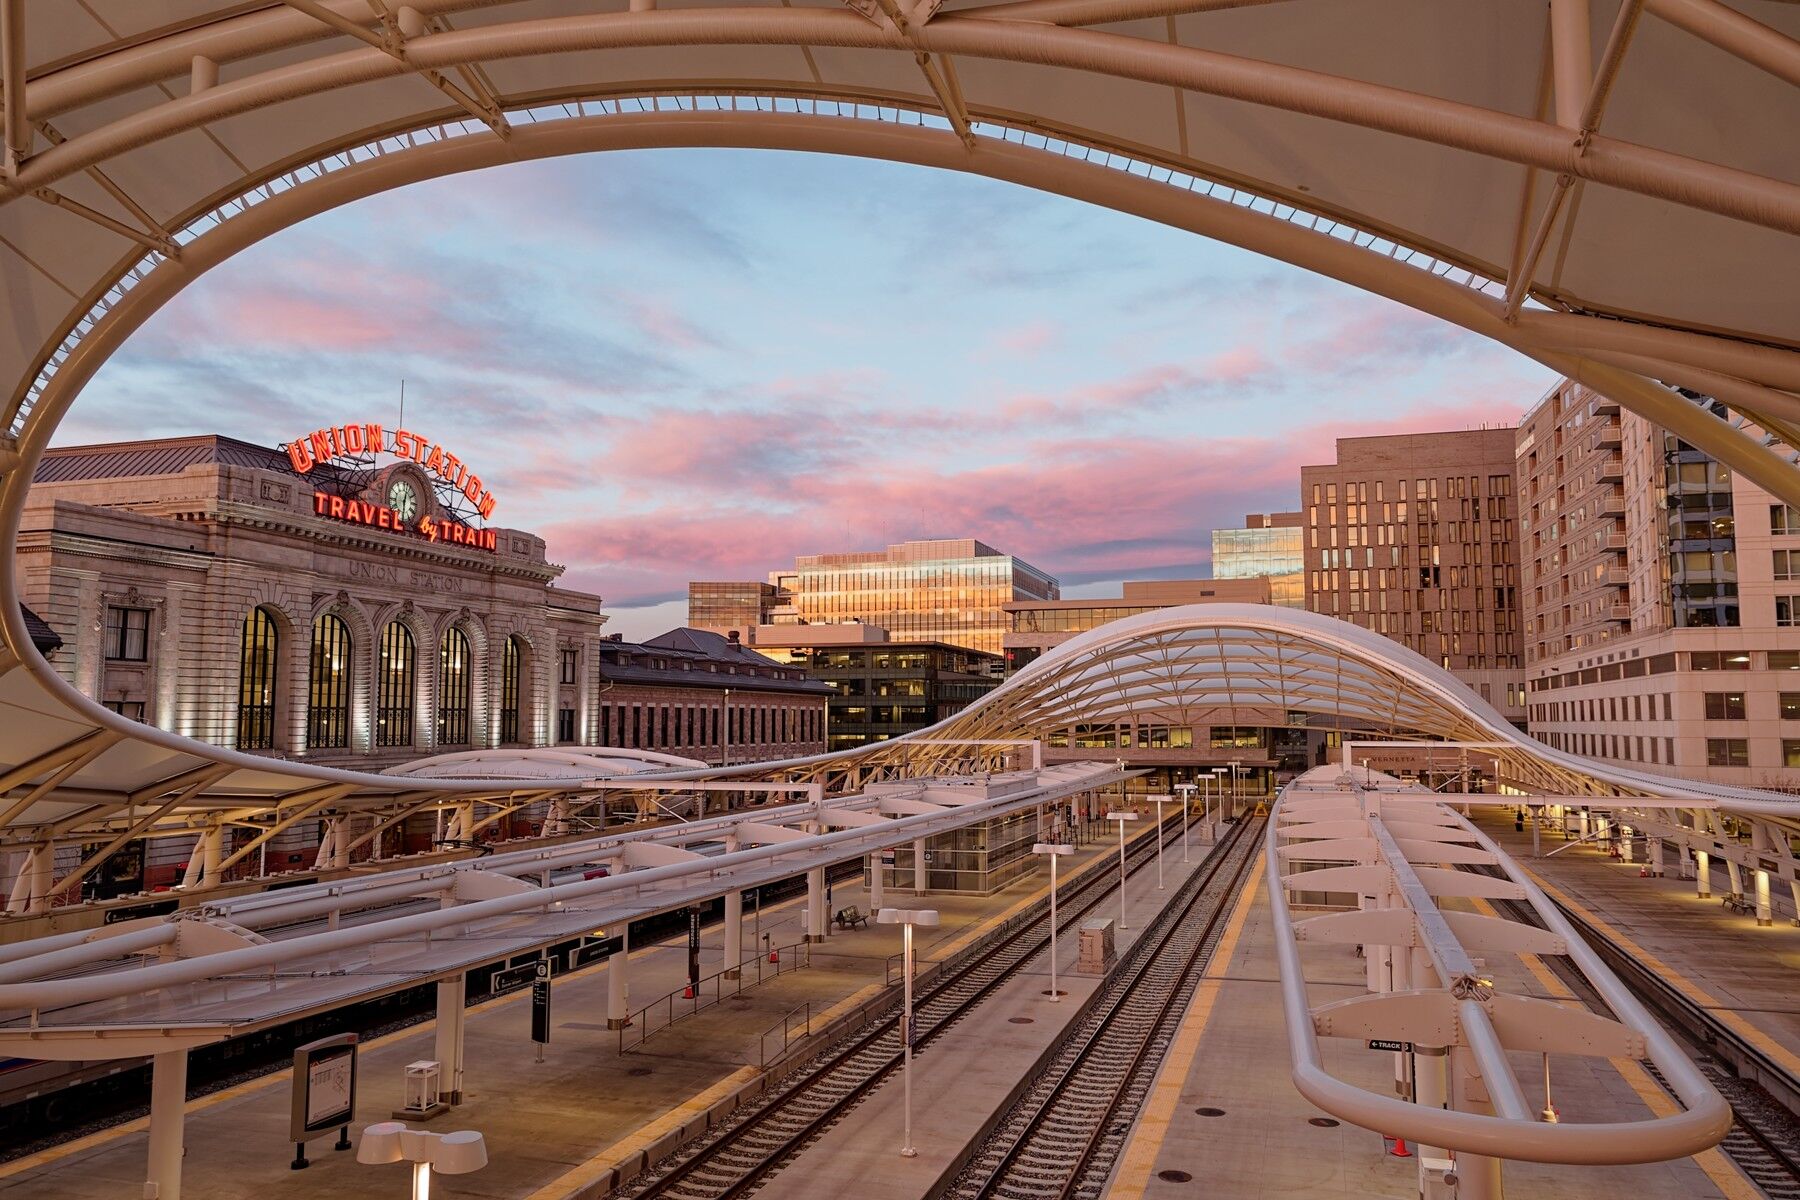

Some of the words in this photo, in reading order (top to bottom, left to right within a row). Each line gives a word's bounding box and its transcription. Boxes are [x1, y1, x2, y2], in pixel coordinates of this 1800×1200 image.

[287, 424, 384, 474] UNION
[395, 427, 498, 521] STATION
[314, 491, 404, 531] TRAVEL
[418, 514, 438, 543] by
[441, 520, 497, 550] TRAIN
[350, 560, 399, 585] UNION
[409, 571, 463, 592] STATION
